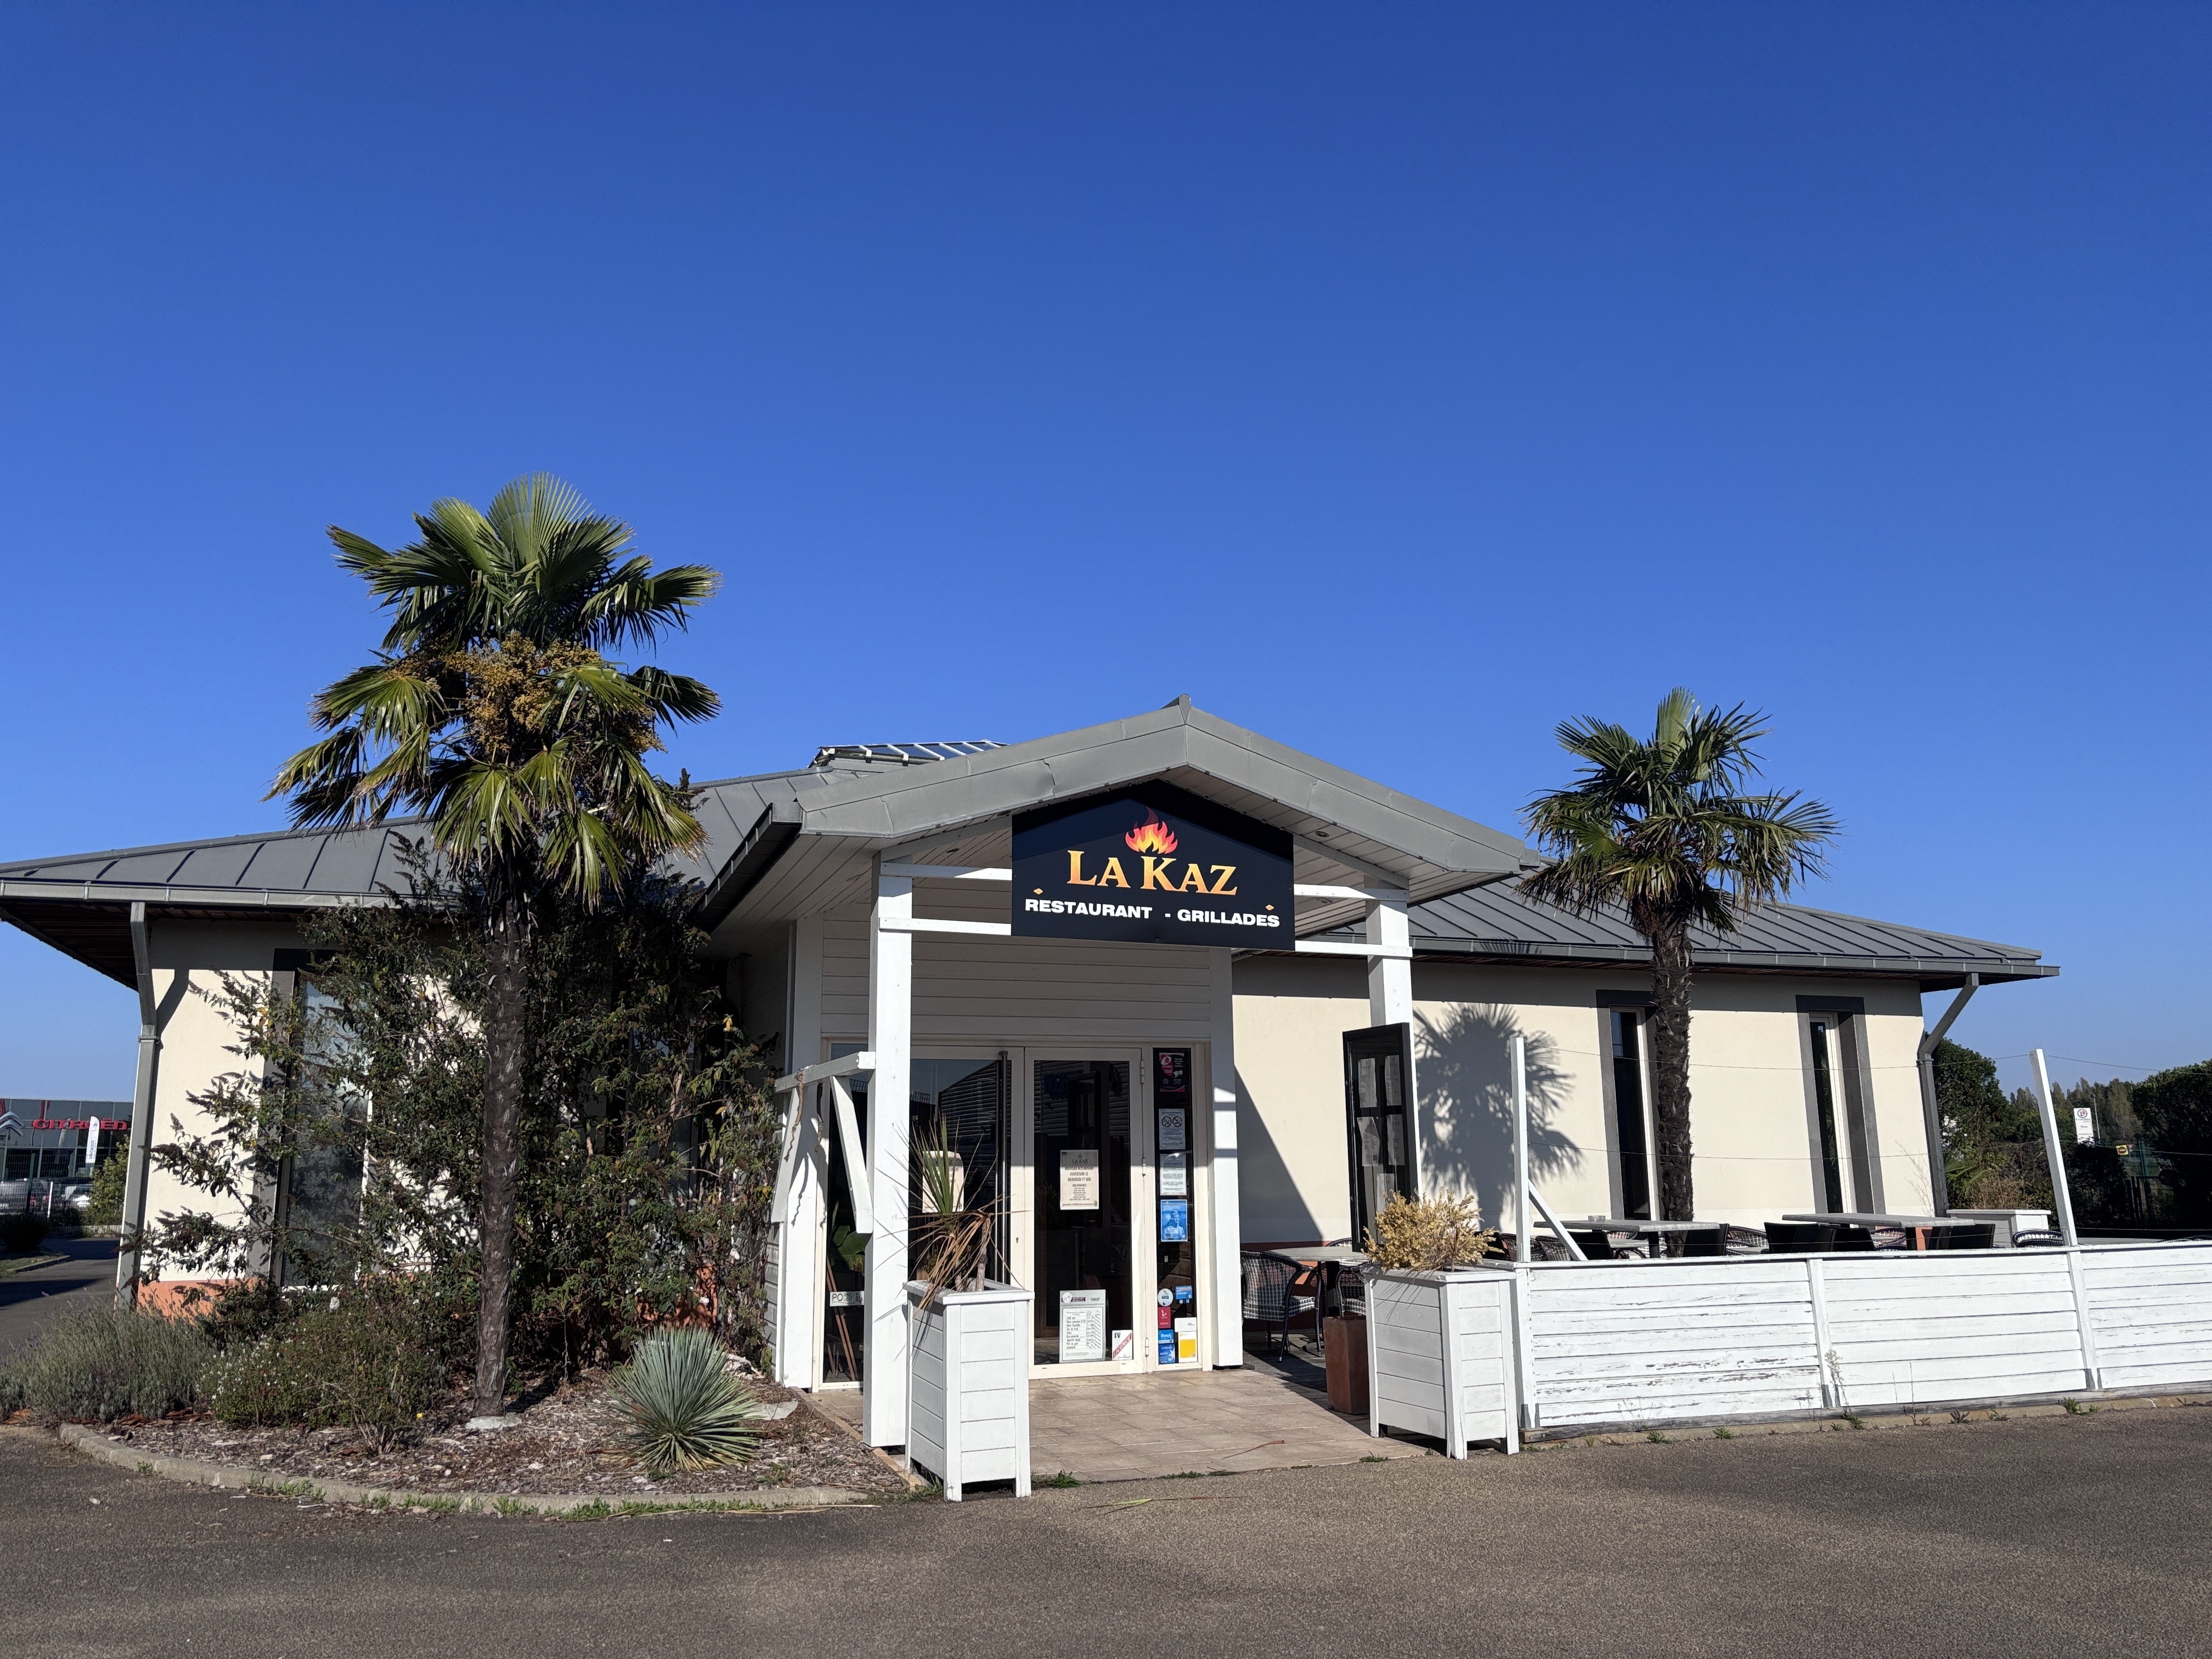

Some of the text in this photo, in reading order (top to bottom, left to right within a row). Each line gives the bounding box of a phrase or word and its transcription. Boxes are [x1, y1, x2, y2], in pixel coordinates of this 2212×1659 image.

[1067, 850, 1238, 896] LA KAZ
[1025, 899, 1153, 919] RESTAURANT
[1177, 909, 1280, 927] GRILLADES
[1113, 1334, 1132, 1358] LICENCE
